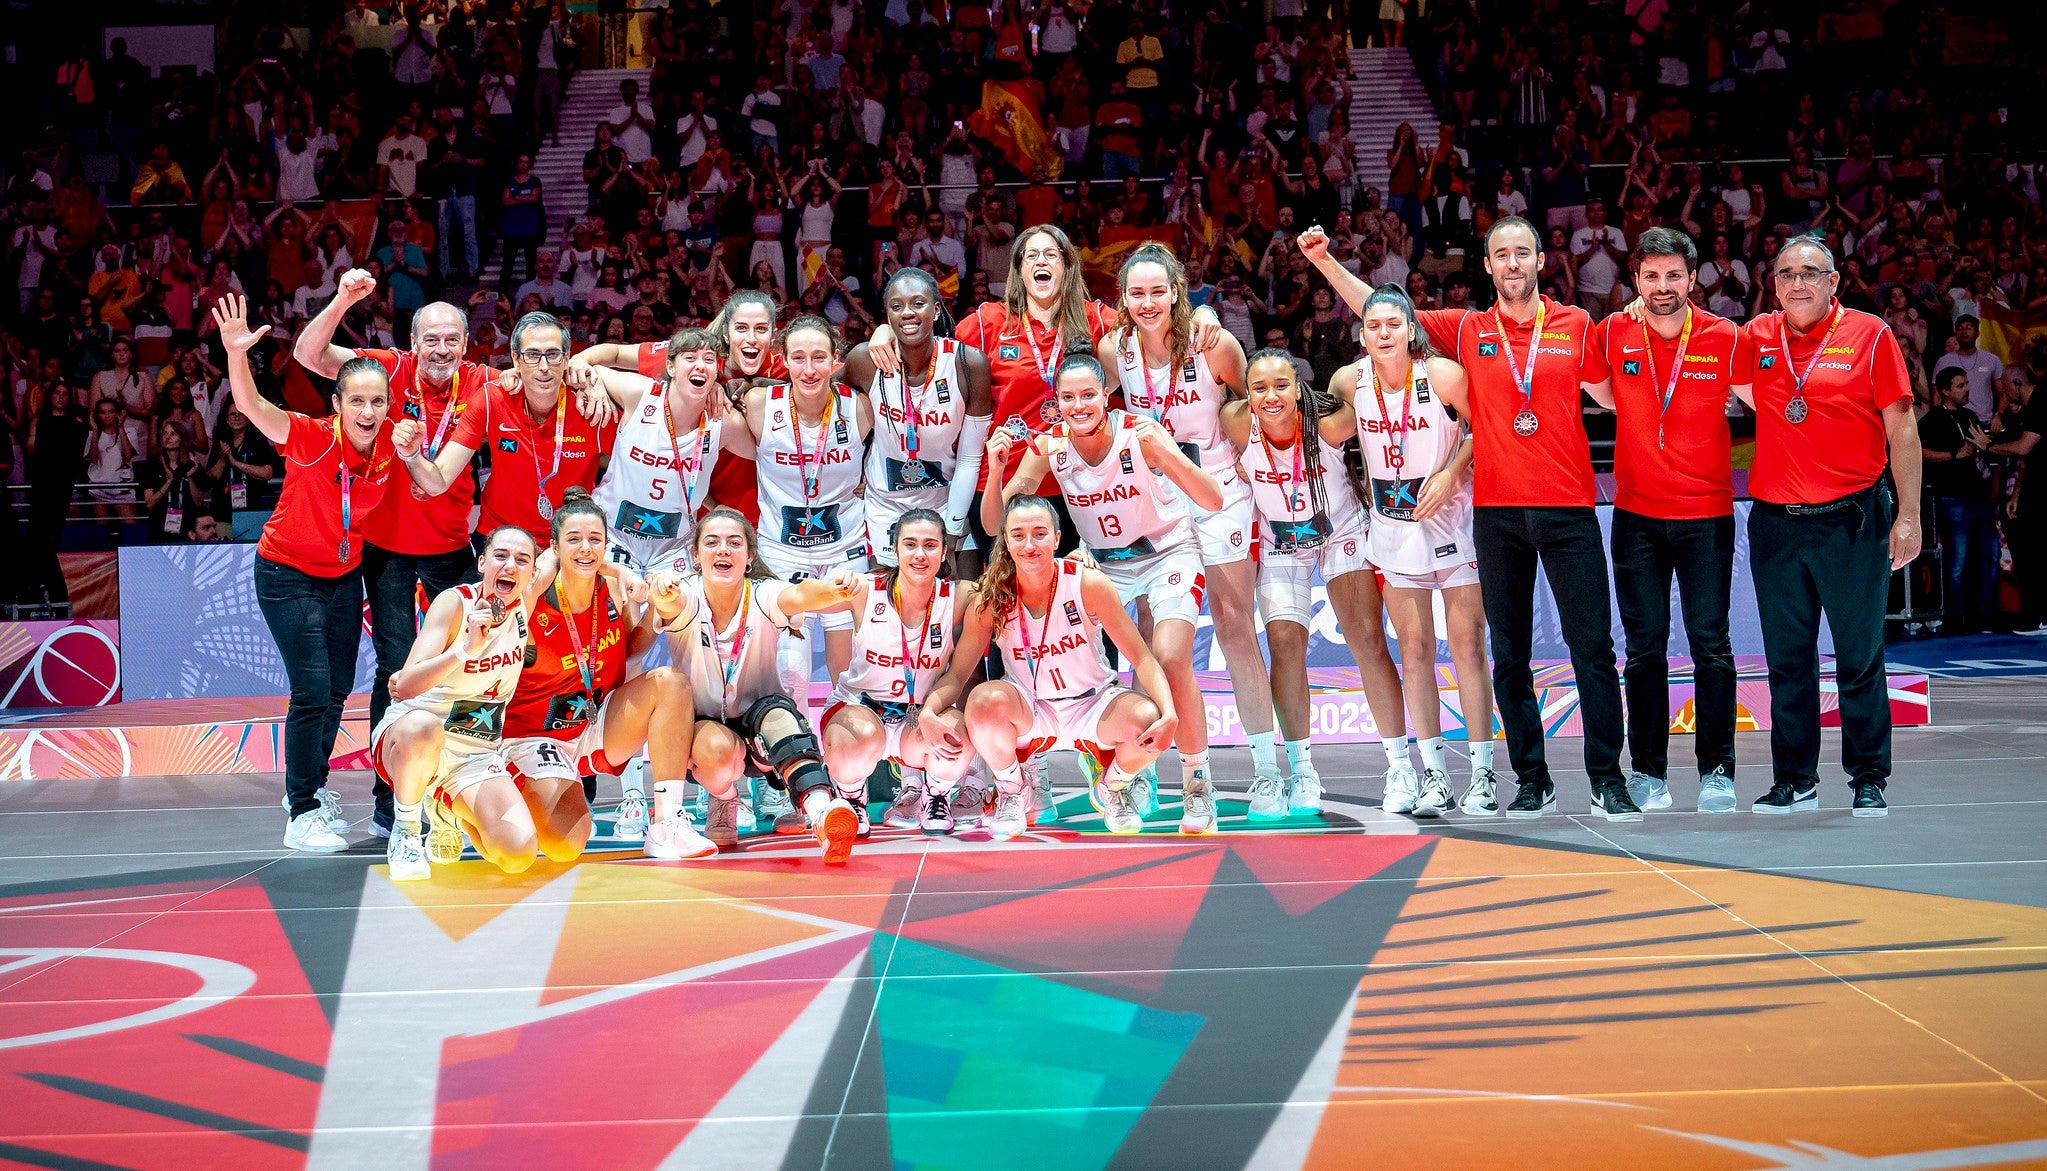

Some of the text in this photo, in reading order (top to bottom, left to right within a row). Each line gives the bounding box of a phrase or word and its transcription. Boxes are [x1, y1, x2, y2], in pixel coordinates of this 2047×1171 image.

[1537, 346, 1573, 356] endesa
[1684, 354, 1718, 363] ESPAÑA
[1683, 371, 1717, 380] endesa
[1818, 361, 1852, 371] endesa
[1383, 446, 1405, 468] 18
[649, 479, 668, 500] 5
[1067, 485, 1140, 507] ESPAÑA
[1382, 507, 1417, 520] CaixaBa
[1097, 515, 1123, 537] 13
[788, 534, 835, 546] CaixaBank
[1268, 549, 1298, 557] network
[561, 628, 620, 671] ESAÑA
[1013, 634, 1088, 661] ESPAÑA
[464, 645, 525, 674] ESPAÑ
[890, 679, 907, 698] 9
[1048, 667, 1067, 691] 11
[484, 680, 501, 700] 4
